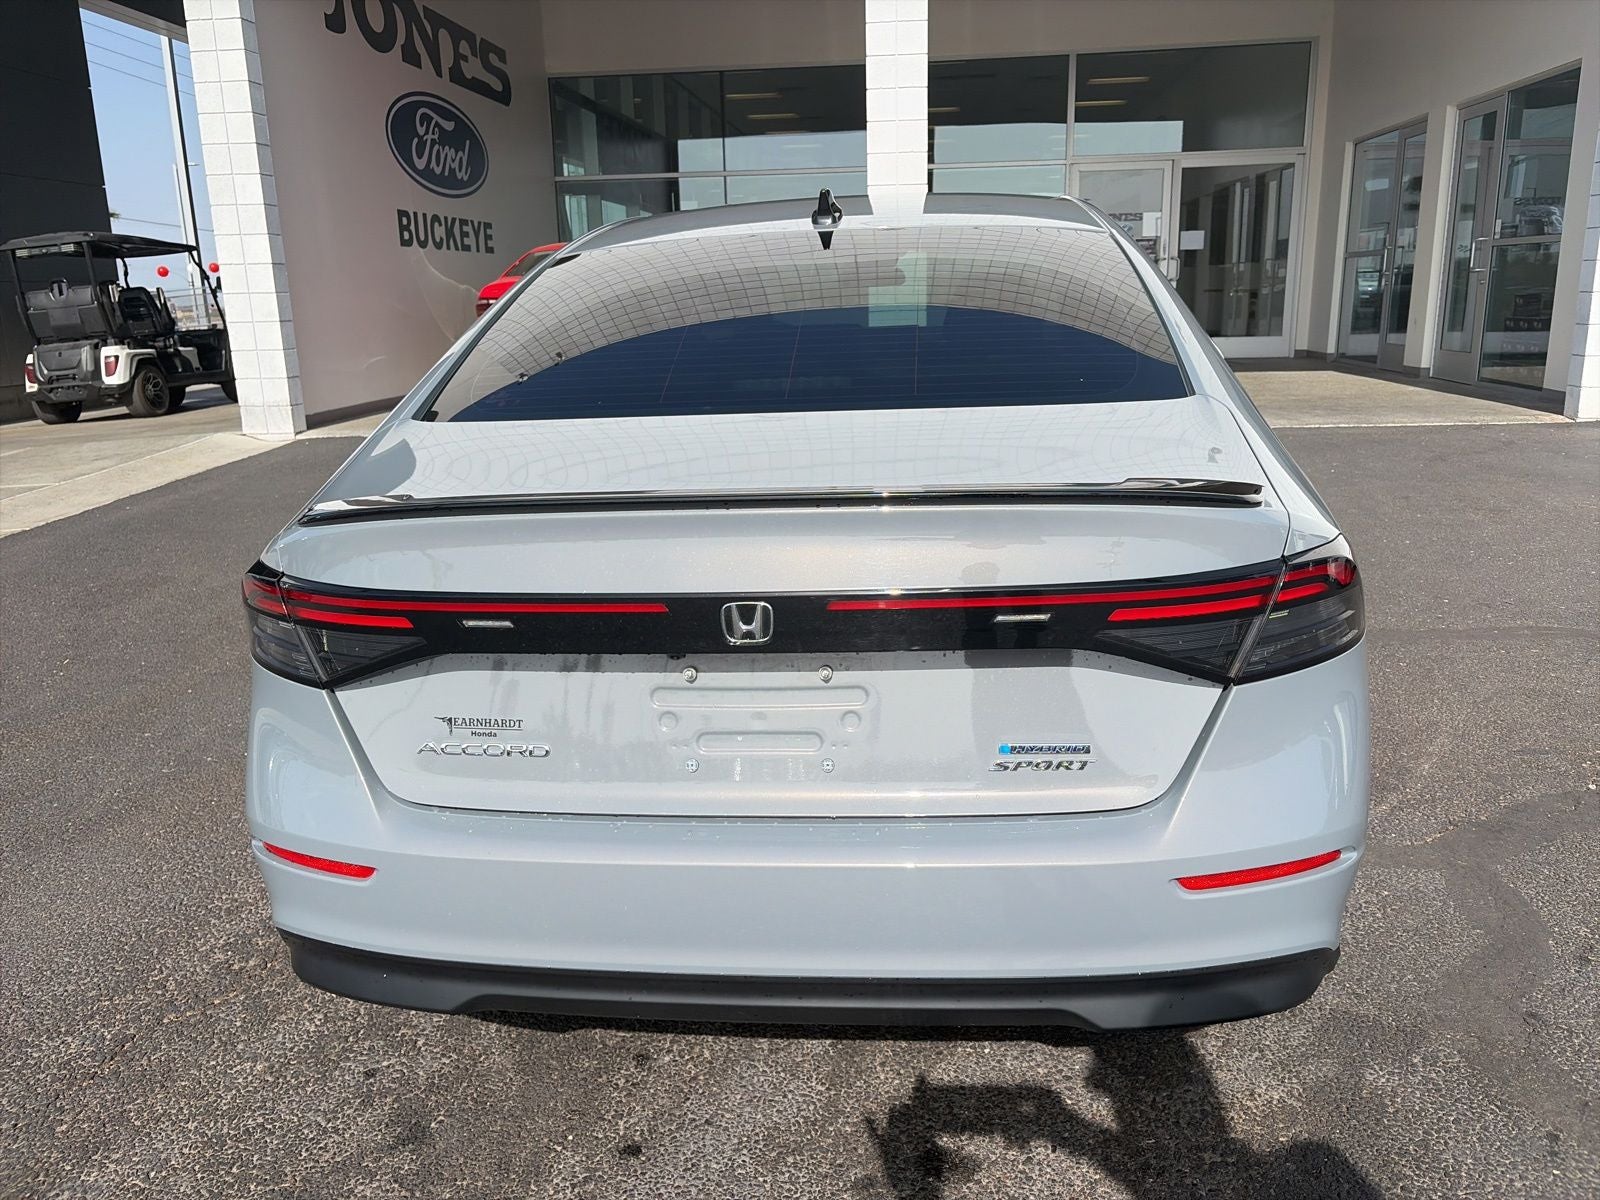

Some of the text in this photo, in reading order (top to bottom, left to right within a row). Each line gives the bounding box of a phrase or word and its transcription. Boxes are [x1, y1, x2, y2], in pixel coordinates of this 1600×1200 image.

[412, 107, 471, 182] Ford
[397, 208, 495, 254] BUCKEYE
[453, 717, 524, 729] EARNHARDT
[471, 730, 497, 738] Honda
[417, 741, 551, 757] ACCORD
[1011, 744, 1086, 753] HYBRID
[989, 760, 1097, 771] SPORT
